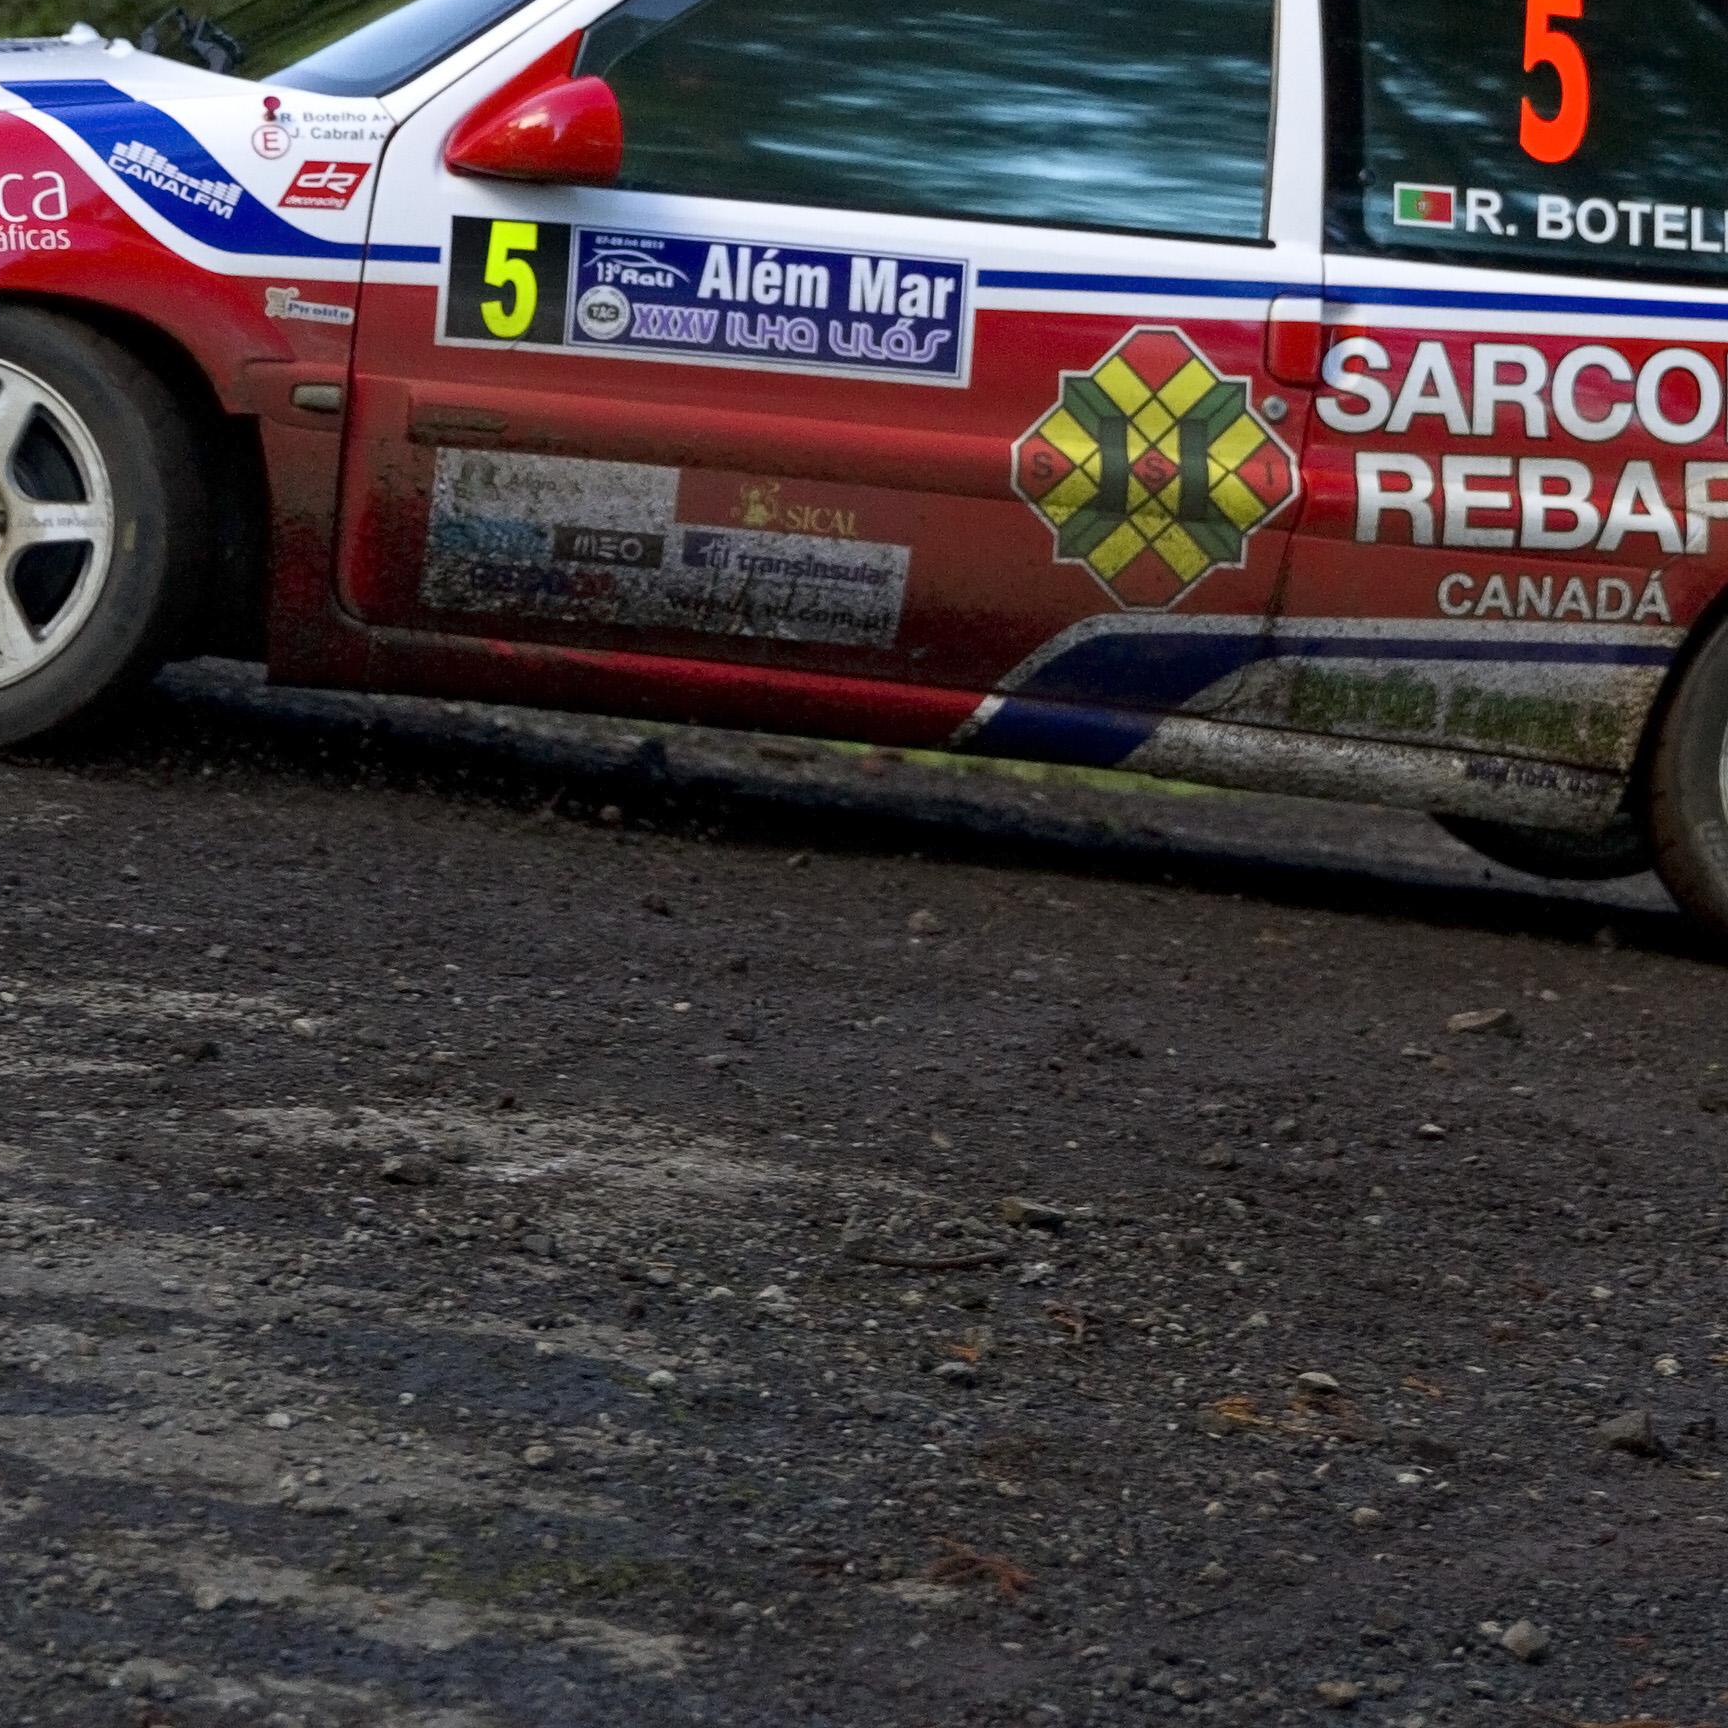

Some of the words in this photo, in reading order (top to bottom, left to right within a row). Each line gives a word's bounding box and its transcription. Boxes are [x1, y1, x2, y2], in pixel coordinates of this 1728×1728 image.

[303, 112, 367, 123] Botelho
[310, 127, 364, 141] Cabral
[1465, 187, 1518, 237] R.
[479, 220, 539, 339] 5
[697, 243, 830, 309] Além
[848, 255, 956, 320] Mar
[630, 303, 719, 345] XXXV
[785, 504, 858, 539] SICAL
[1437, 569, 1672, 624] CANADÁ
